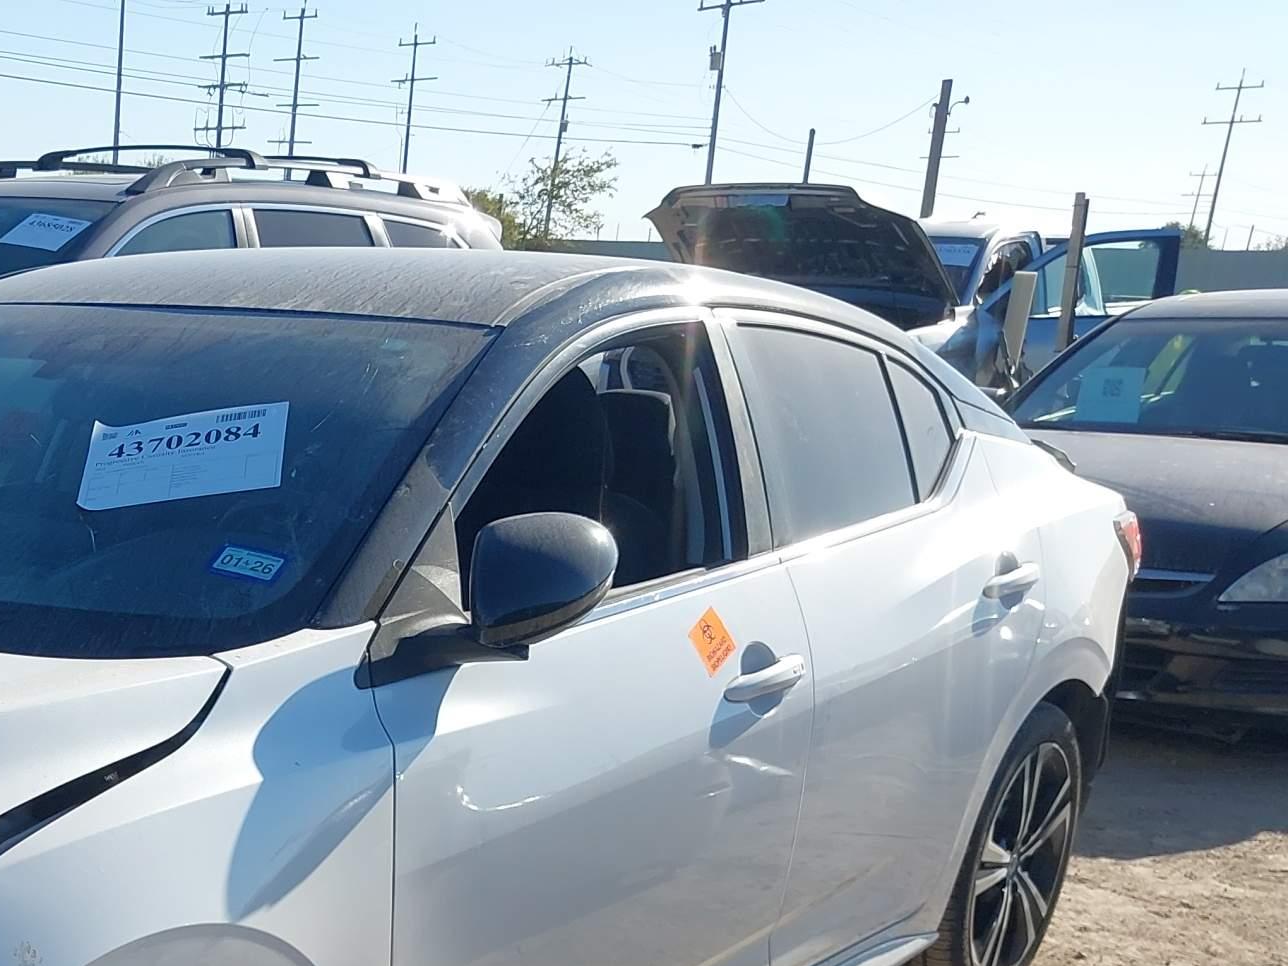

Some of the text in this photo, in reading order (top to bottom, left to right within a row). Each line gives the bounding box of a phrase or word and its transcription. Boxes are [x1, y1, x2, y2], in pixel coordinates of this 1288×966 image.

[108, 422, 262, 459] 43702084
[220, 554, 244, 567] 01
[249, 560, 275, 574] 26
